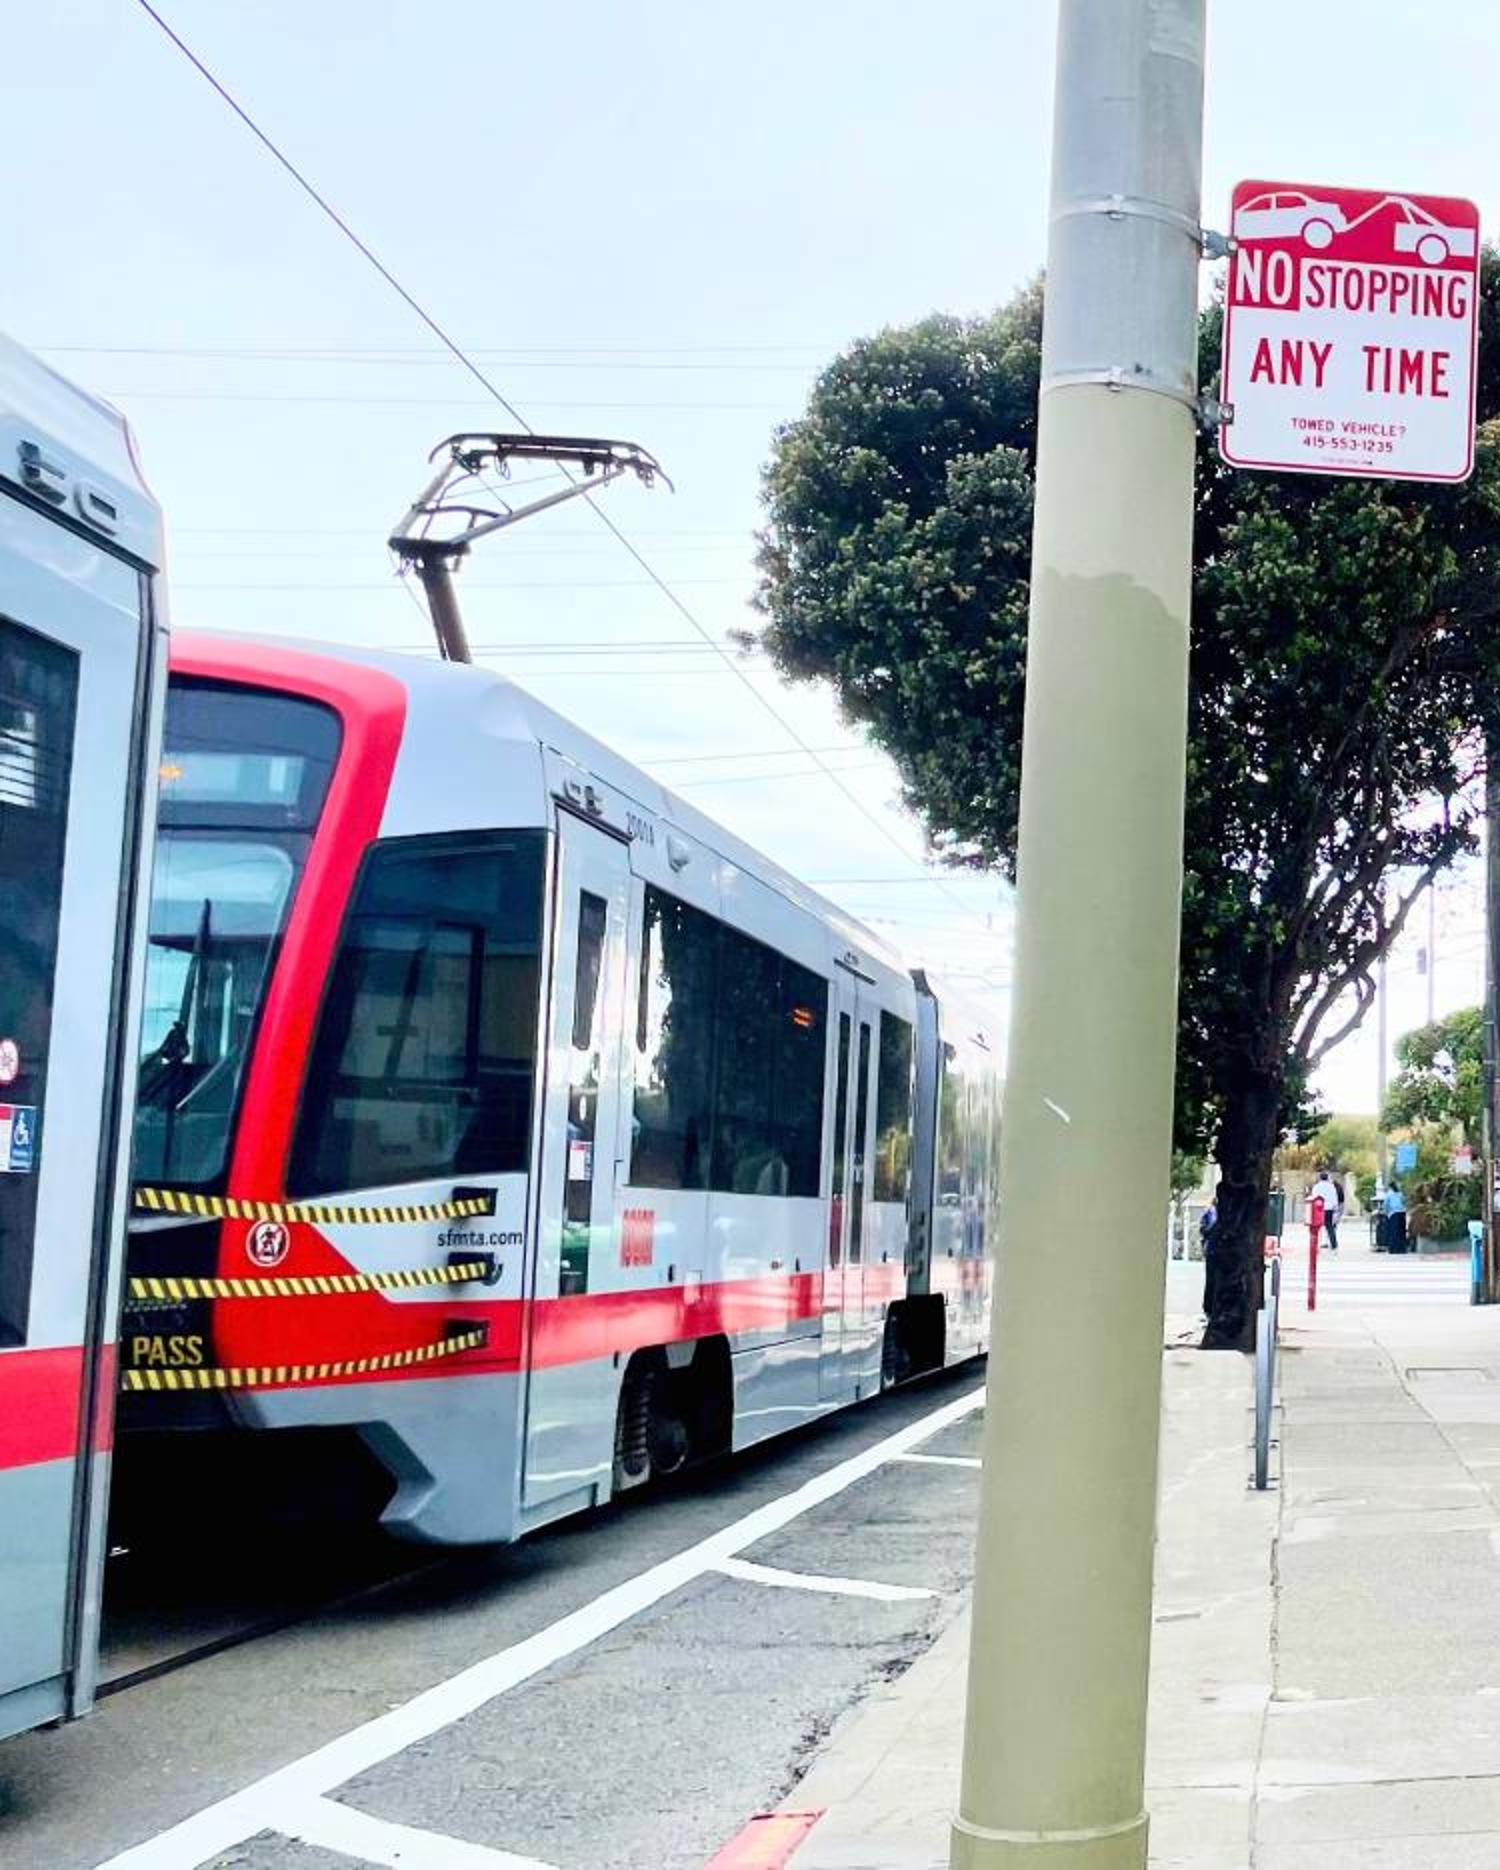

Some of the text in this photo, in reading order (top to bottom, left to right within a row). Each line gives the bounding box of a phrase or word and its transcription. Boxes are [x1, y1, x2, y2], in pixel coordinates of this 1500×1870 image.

[1236, 248, 1466, 319] NO STOPPING
[1250, 338, 1450, 397] ANY TIME
[1291, 417, 1407, 438] TOWED VEHICLE?
[1303, 436, 1393, 453] 415-553-1235
[437, 1227, 523, 1247] sfmta.com
[133, 1335, 203, 1366] PASS
